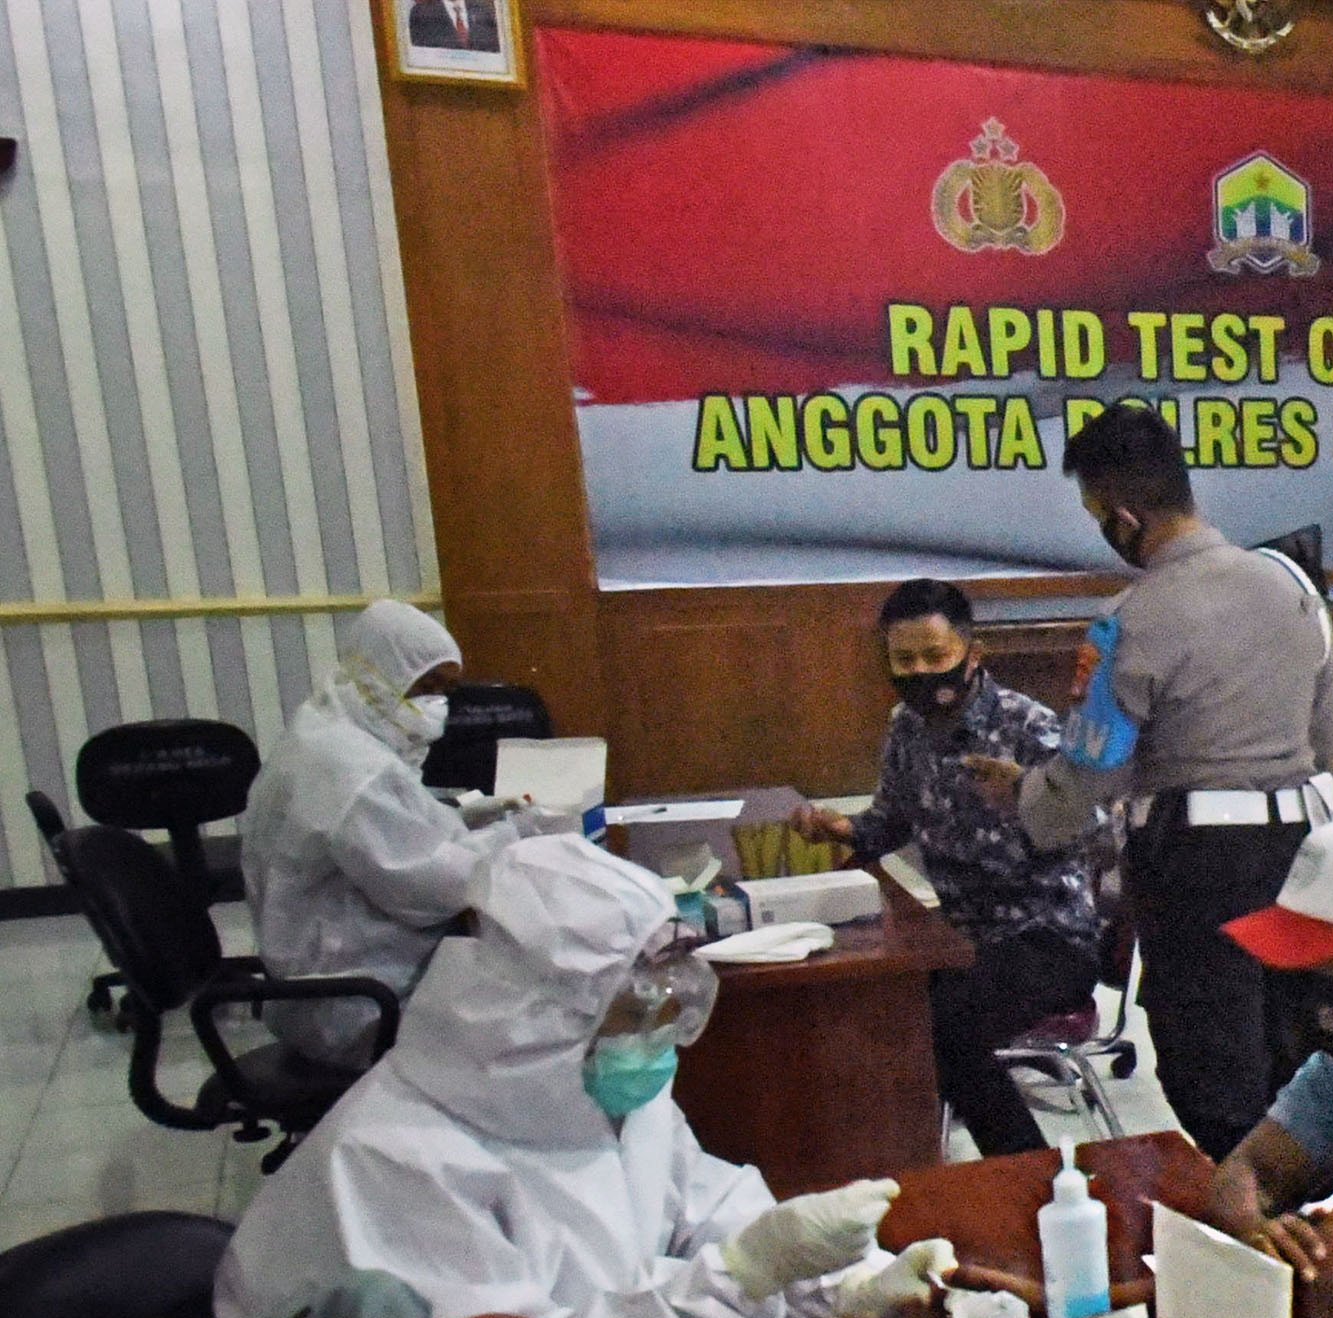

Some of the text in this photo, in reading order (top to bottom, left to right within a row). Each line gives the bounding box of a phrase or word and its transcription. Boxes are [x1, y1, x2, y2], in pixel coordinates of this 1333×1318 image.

[887, 303, 1106, 379] RAPID
[1126, 311, 1286, 382] TEST
[693, 391, 1047, 472] ANGGOTA
[1064, 394, 1318, 469] PRES
